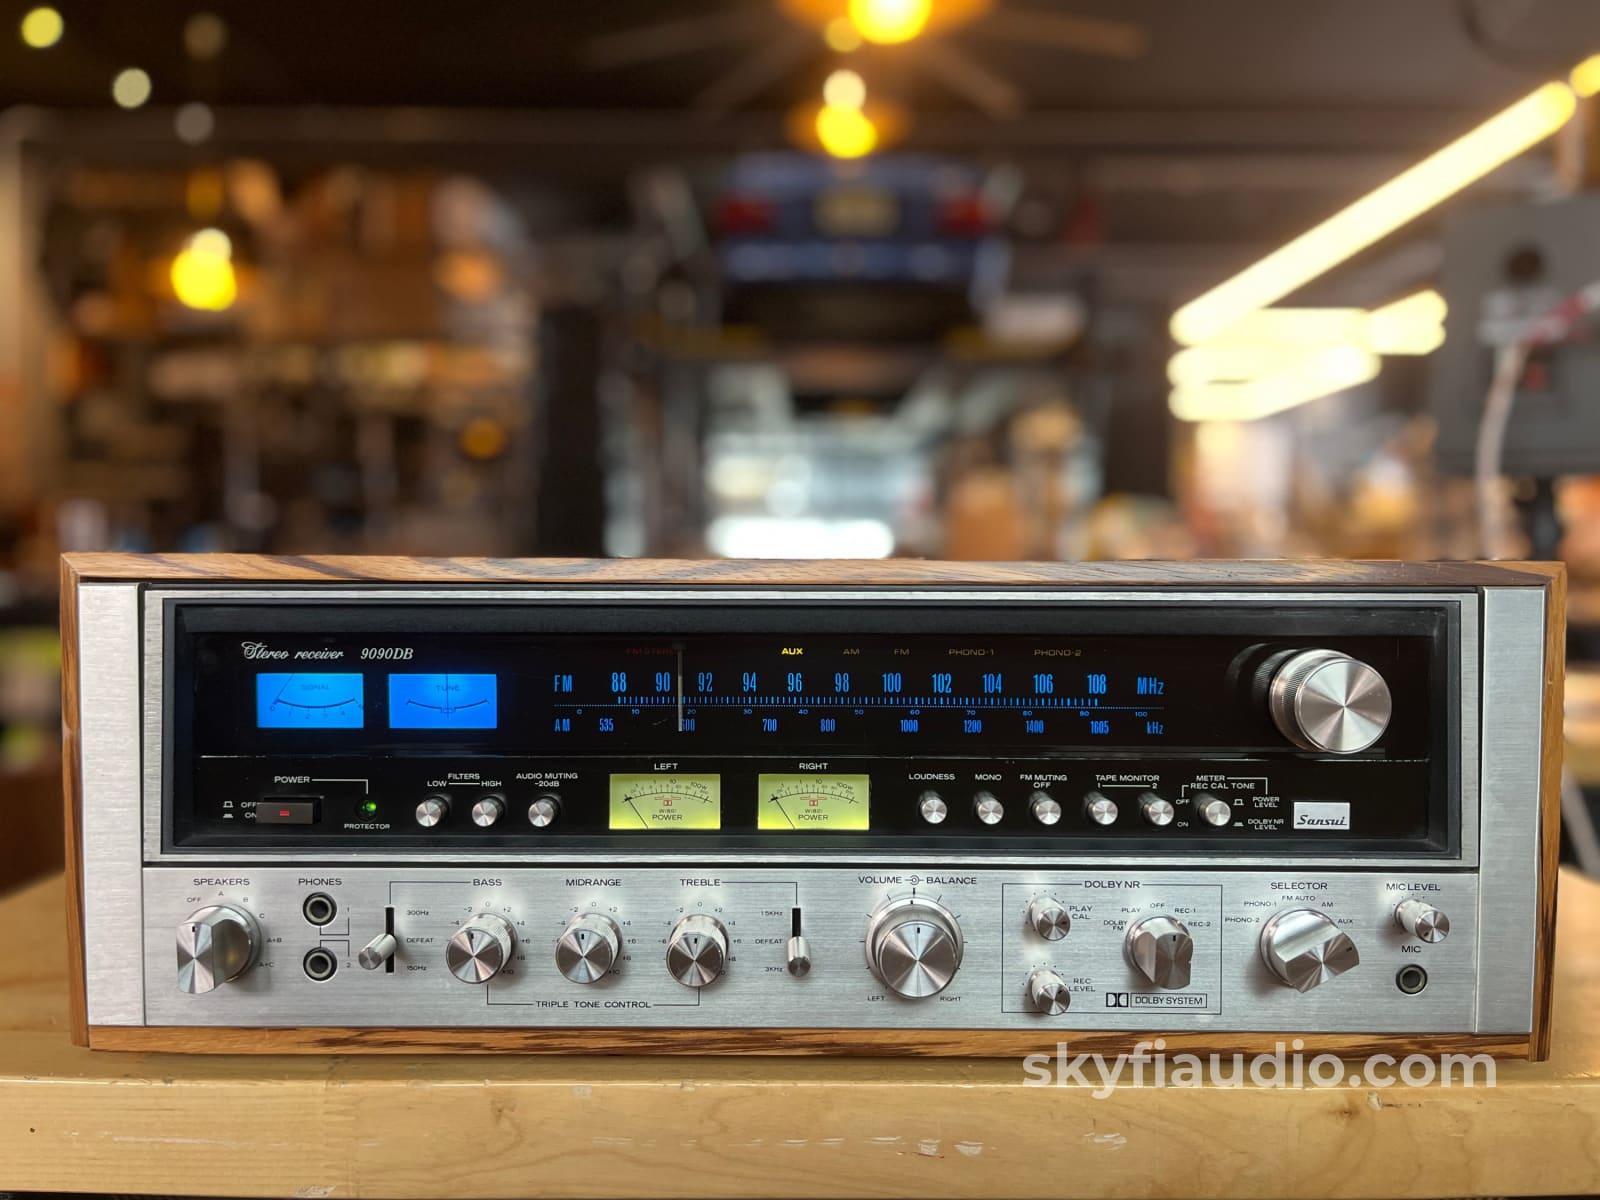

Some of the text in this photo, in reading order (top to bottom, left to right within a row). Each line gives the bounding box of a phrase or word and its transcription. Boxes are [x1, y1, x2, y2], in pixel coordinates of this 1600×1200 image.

[241, 642, 413, 660] Stereo receiver 9090DB
[554, 672, 1164, 695] FM 88 90 92 94 96 98 100 102 104 106 108 MHz
[436, 684, 461, 692] TUNE
[554, 719, 571, 732] AM
[599, 718, 614, 732] 535
[763, 718, 778, 732] 700
[820, 718, 835, 732] 800
[900, 719, 919, 733] 1000
[963, 719, 982, 733] 1200
[1025, 719, 1044, 733] 1400
[1090, 720, 1109, 734] 1605
[1147, 721, 1164, 735] kHz
[799, 762, 829, 770] RIGHT
[274, 776, 310, 784] POWER
[1095, 774, 1160, 782] TAPE MONITOR
[1296, 815, 1348, 826] Sansui
[193, 878, 250, 886] SPEAKERS
[298, 878, 342, 886] PHONES
[565, 879, 621, 887] MIDRANGE
[680, 879, 721, 887] TREBLE
[858, 876, 902, 884] VOLUME
[926, 876, 977, 885] BALANCE
[1084, 880, 1140, 889] DOLBY NR
[1270, 882, 1328, 890] SELECTOR
[1386, 883, 1406, 891] MIC
[1135, 996, 1203, 1005] DOLBY SYSTEM
[536, 1001, 652, 1009] TRIPLE TONE CONTROL
